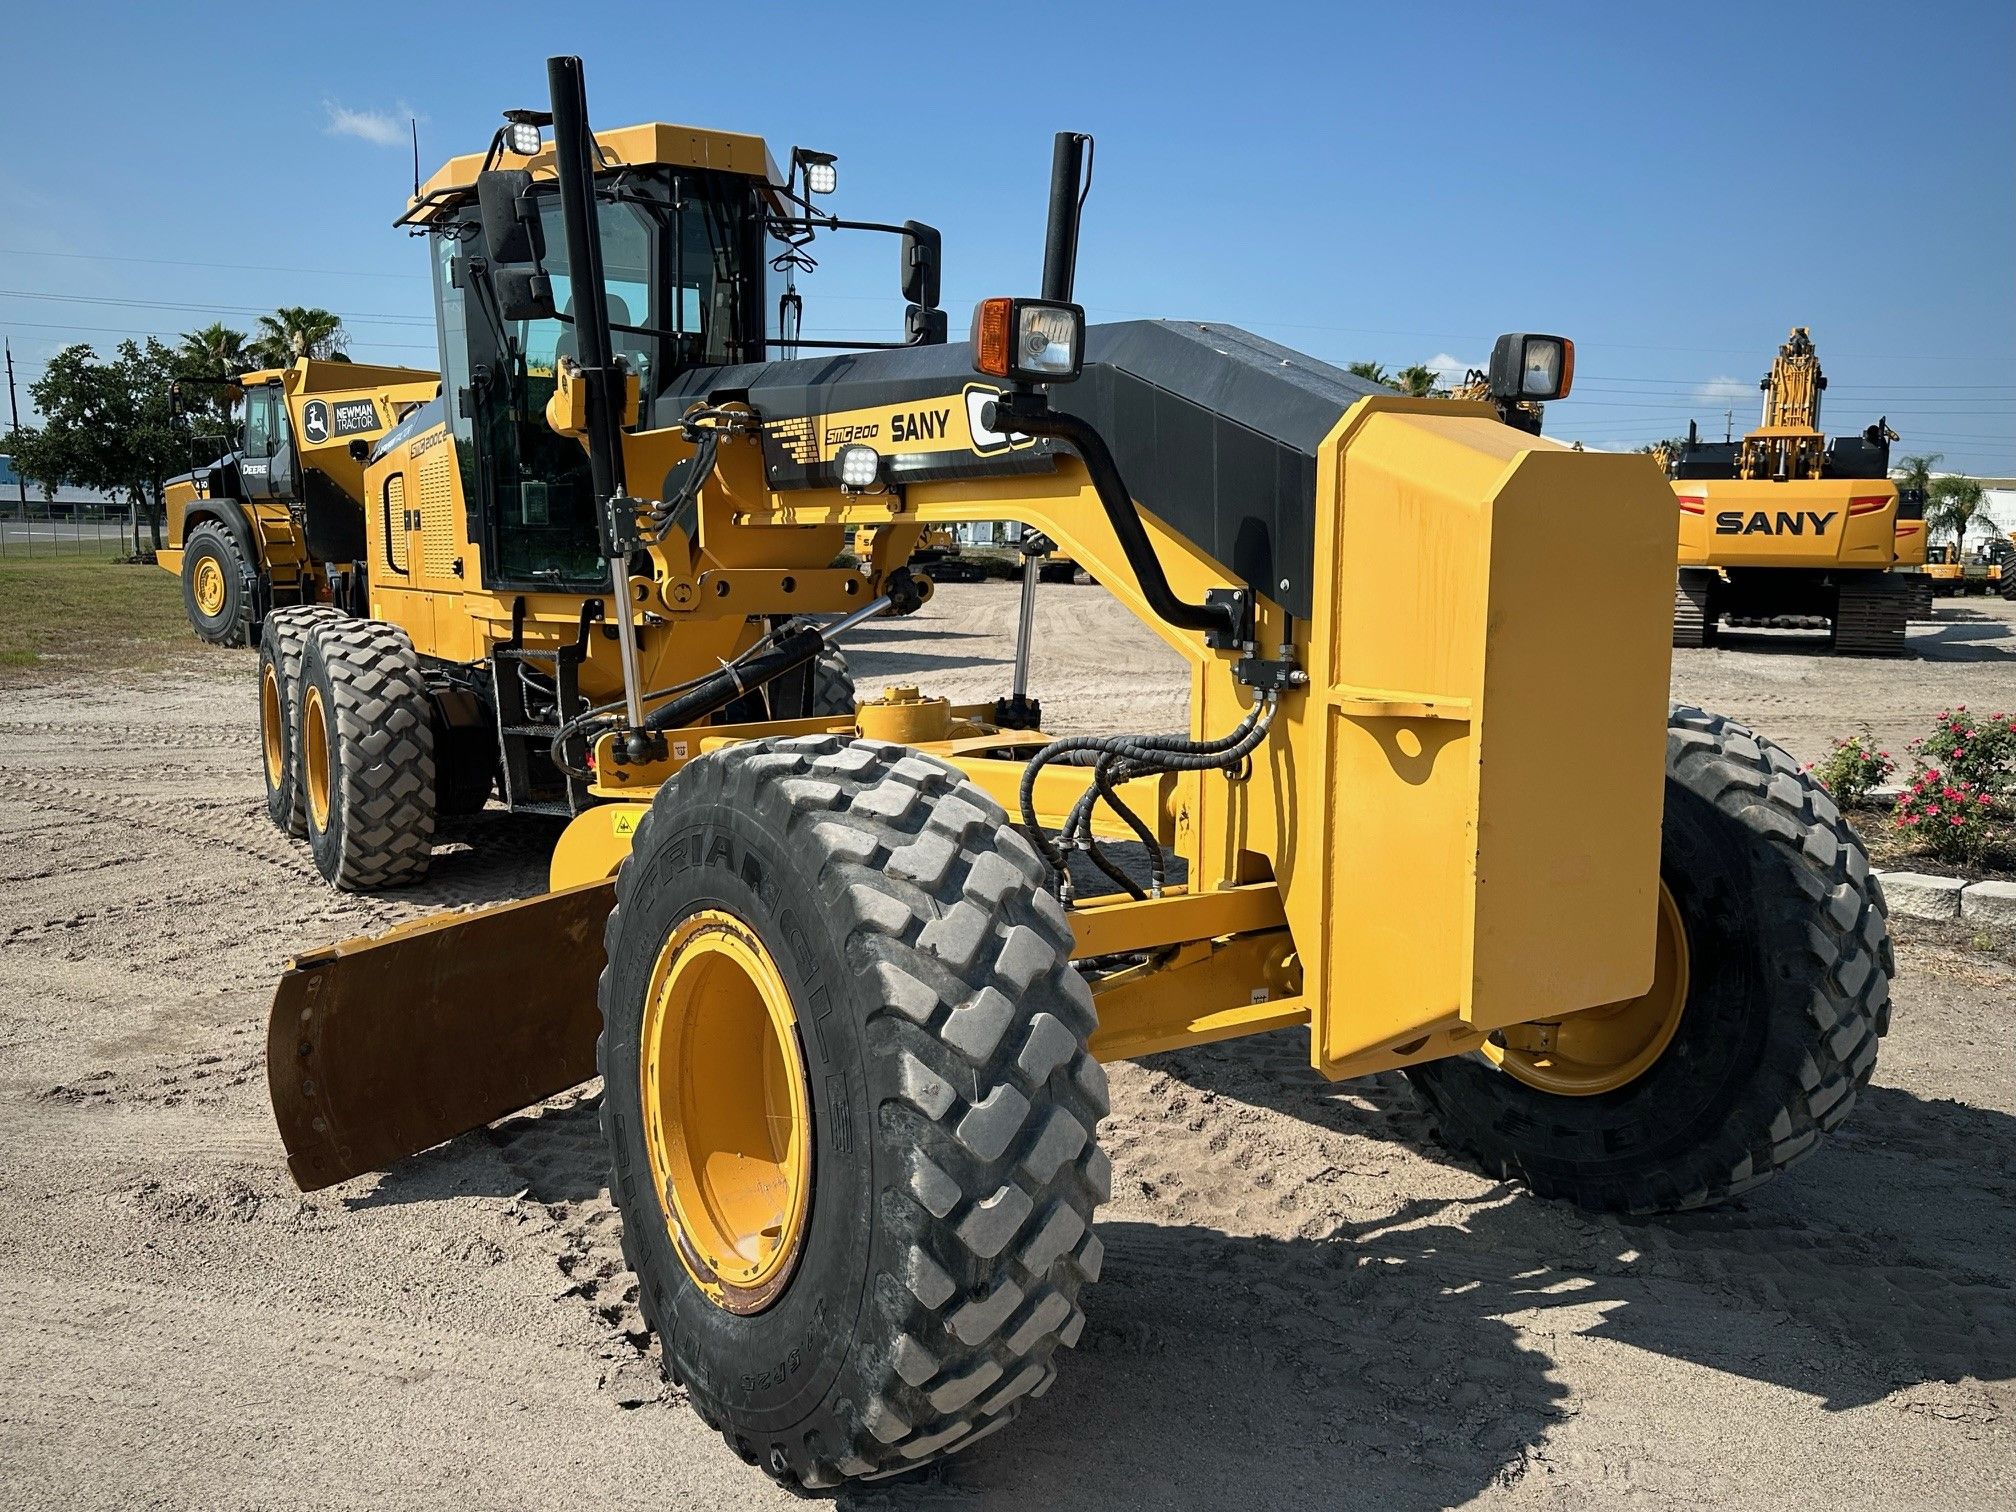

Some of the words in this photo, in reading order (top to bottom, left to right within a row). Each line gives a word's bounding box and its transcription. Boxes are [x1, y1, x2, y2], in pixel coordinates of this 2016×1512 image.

[336, 404, 373, 419] NEWMAN
[337, 415, 373, 430] TRACTOR
[892, 409, 950, 442] SANY
[243, 464, 267, 474] DEERE
[1716, 512, 1838, 535] SANY
